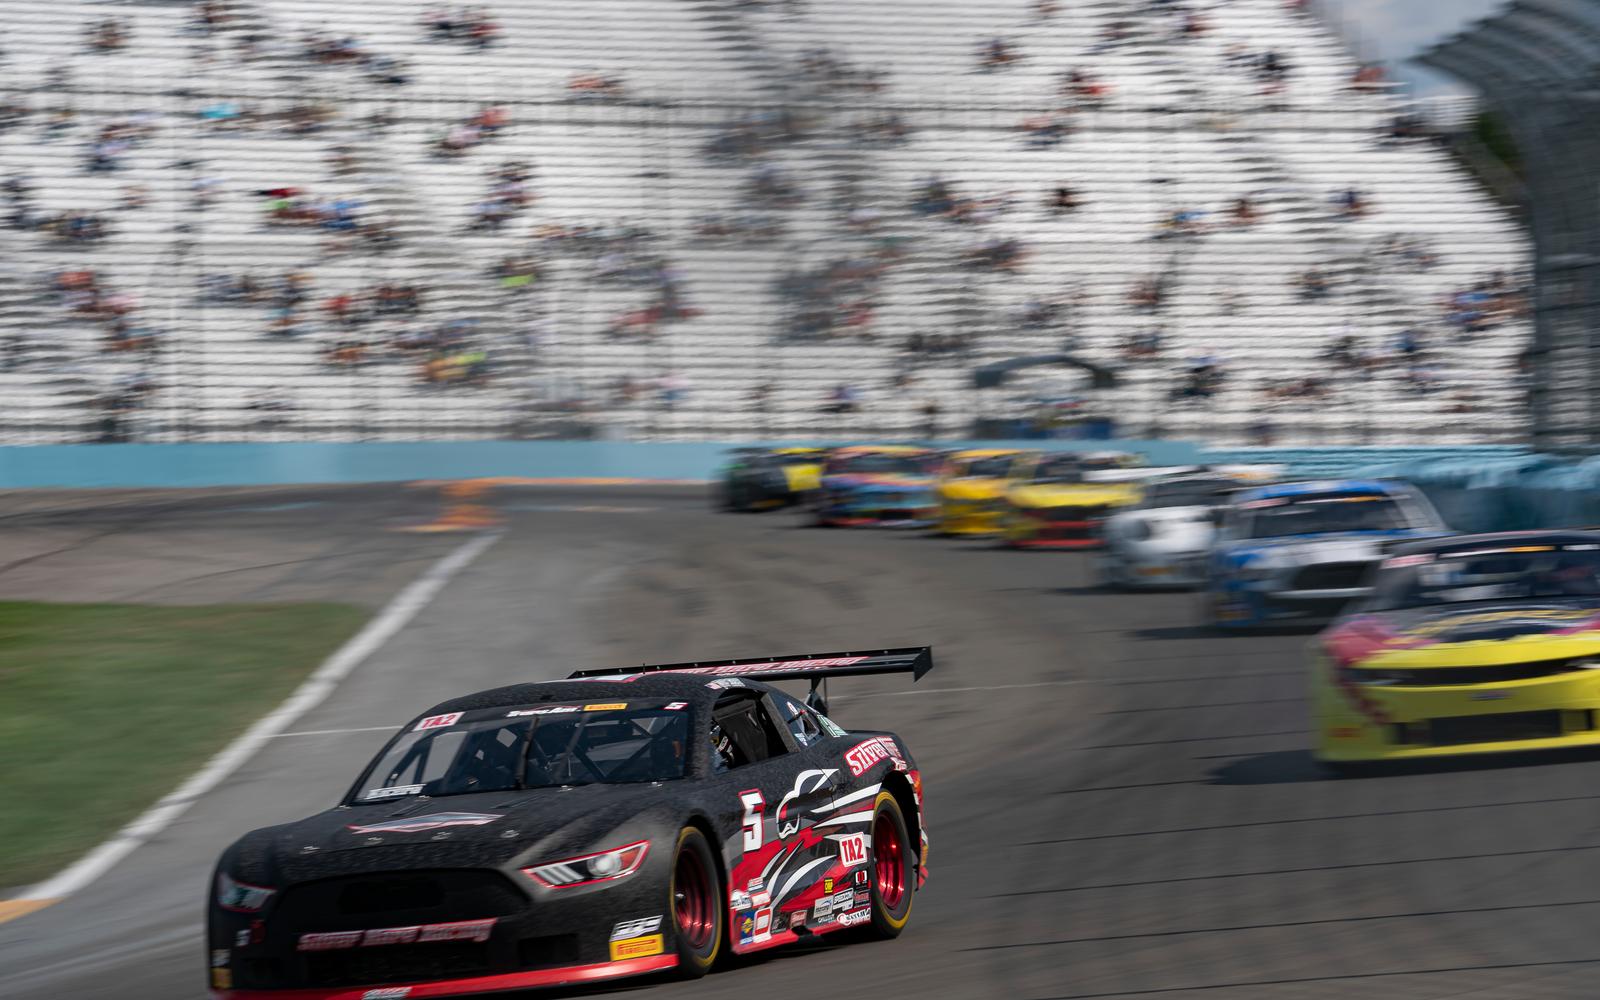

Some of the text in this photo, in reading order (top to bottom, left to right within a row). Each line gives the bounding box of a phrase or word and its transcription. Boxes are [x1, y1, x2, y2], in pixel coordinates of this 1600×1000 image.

[420, 714, 457, 729] TA2
[739, 788, 766, 853] 5
[841, 837, 864, 862] TA2
